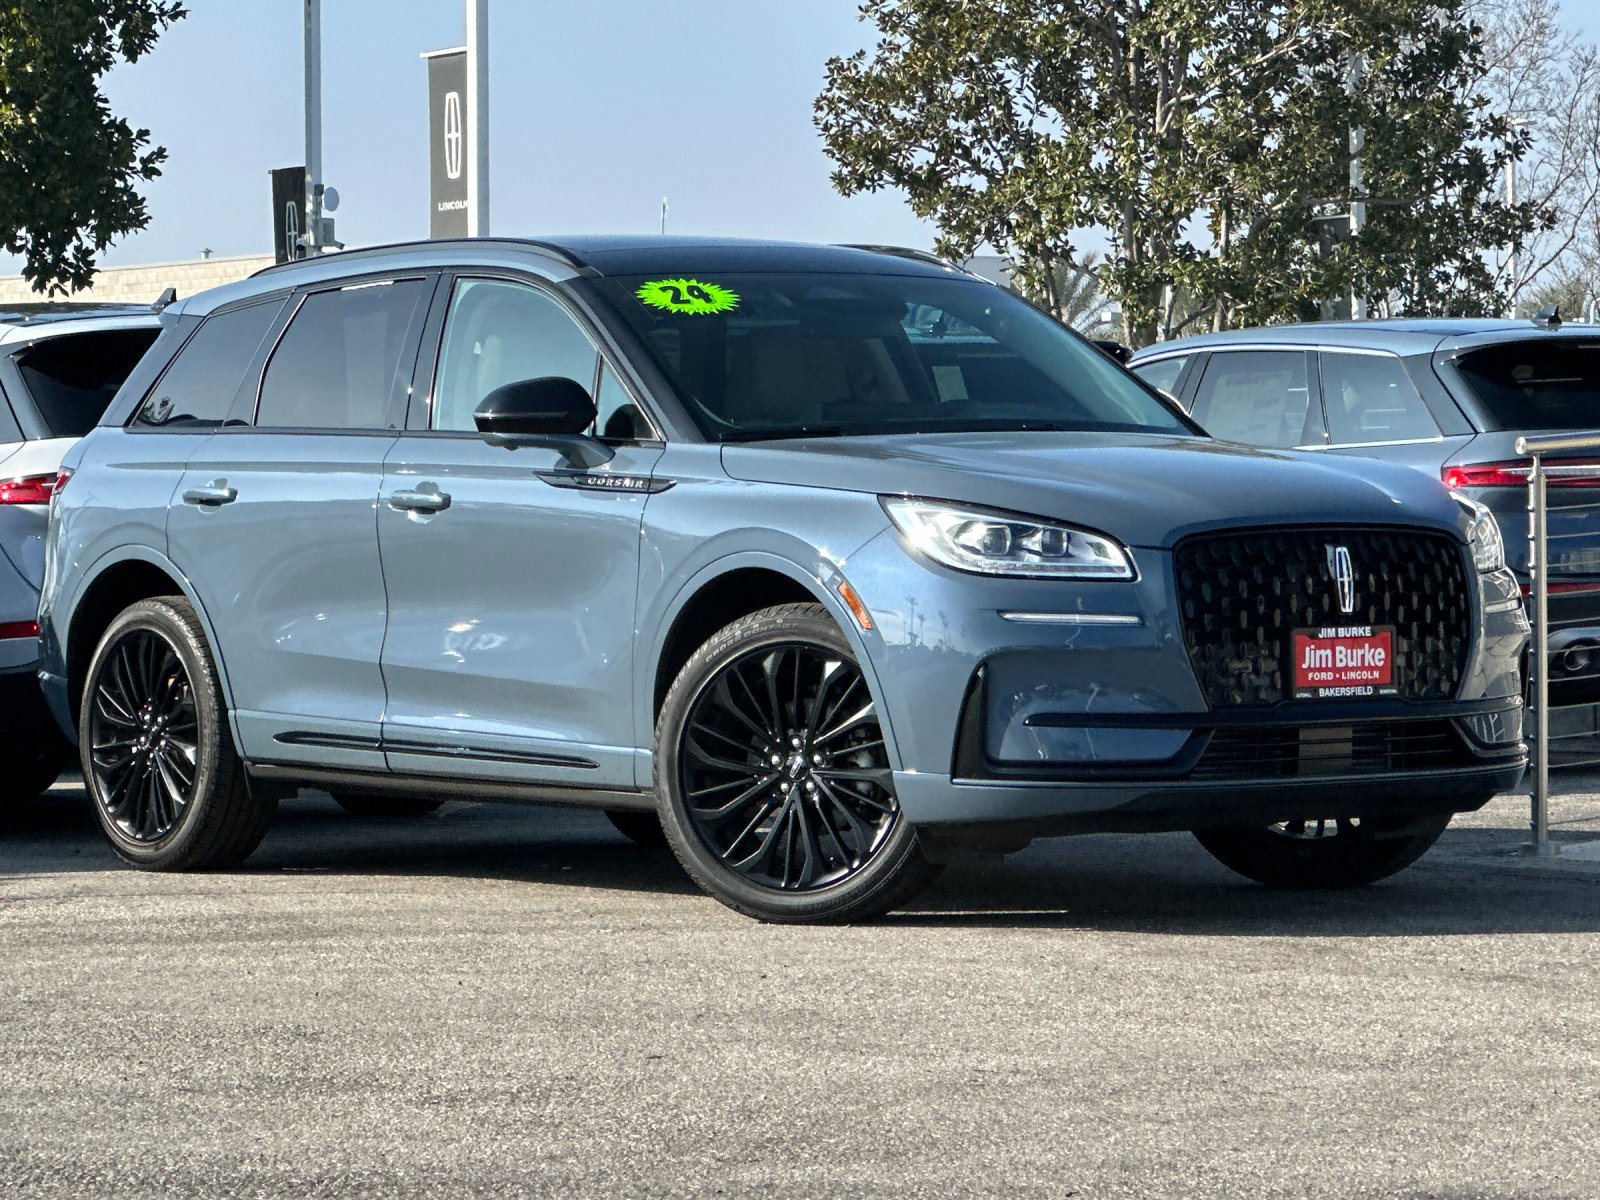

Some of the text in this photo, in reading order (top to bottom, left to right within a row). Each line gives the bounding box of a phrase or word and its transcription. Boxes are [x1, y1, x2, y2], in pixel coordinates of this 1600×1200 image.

[587, 477, 644, 488] CORSAIR
[1318, 626, 1372, 638] JIM BURKE
[1301, 643, 1386, 669] Jim Burke
[1308, 670, 1380, 681] FORD LINCOLN
[1318, 685, 1374, 697] BAKERSFIELD
